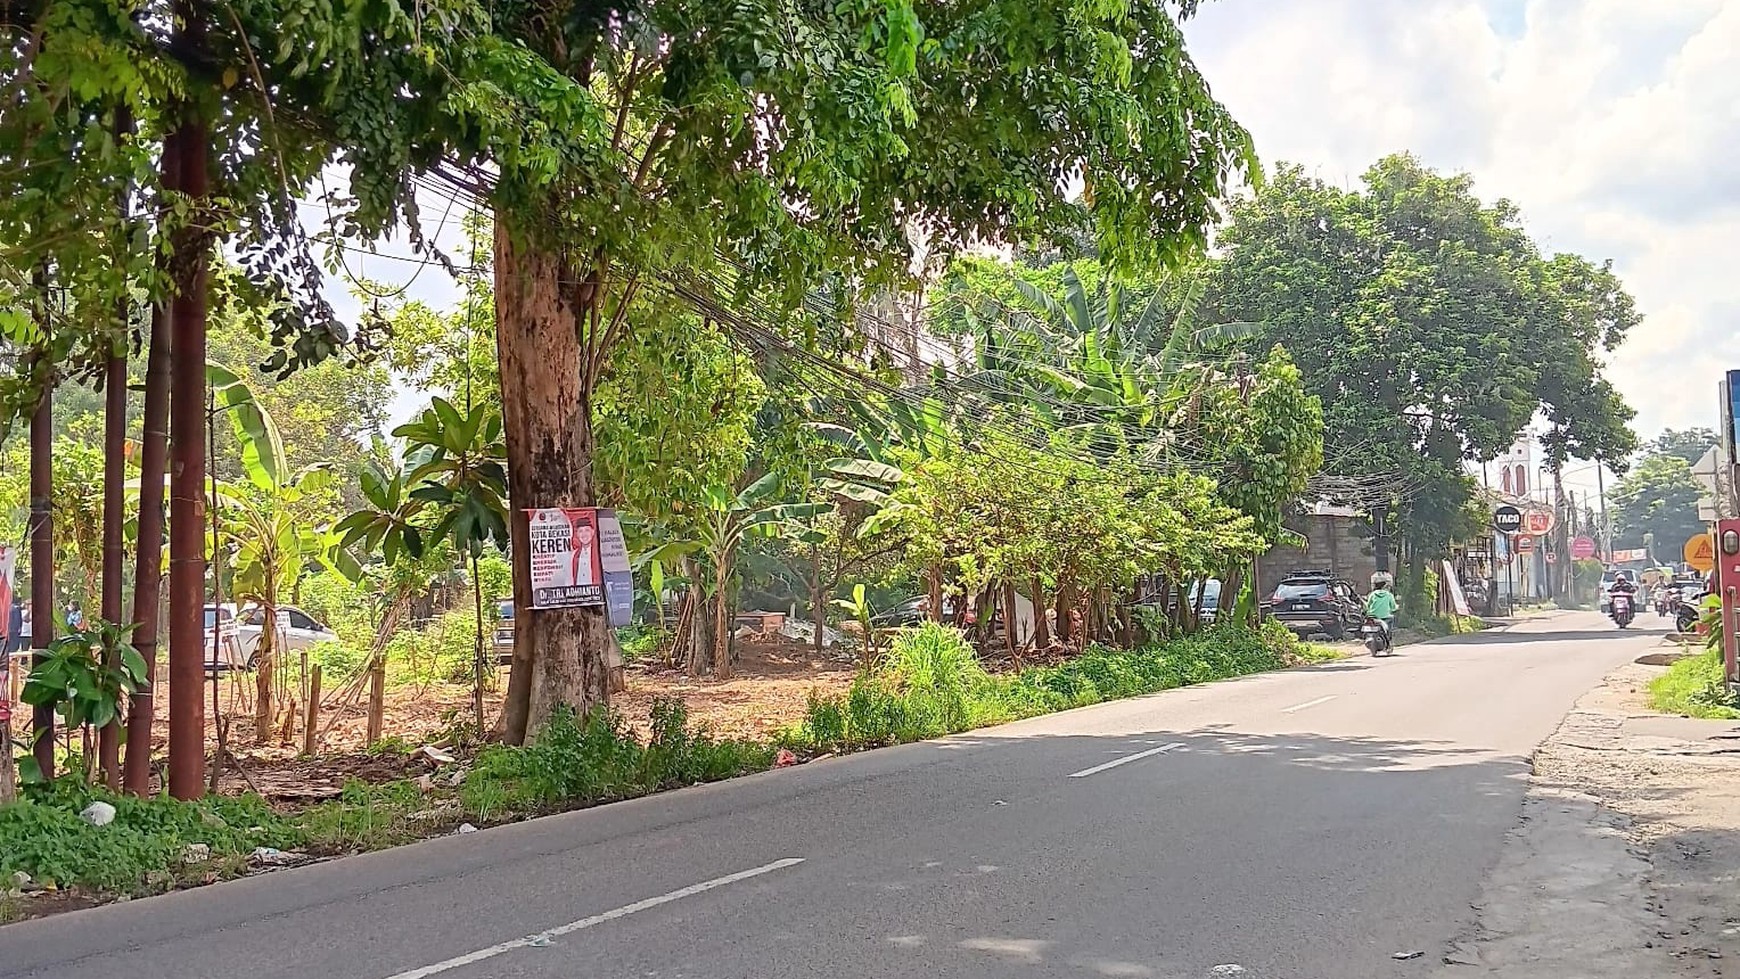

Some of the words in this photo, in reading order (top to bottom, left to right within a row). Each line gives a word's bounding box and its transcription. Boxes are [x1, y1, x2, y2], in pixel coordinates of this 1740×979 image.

[1496, 514, 1519, 523] TACO
[531, 531, 547, 539] KOTA
[548, 529, 571, 538] BEKASI
[532, 538, 571, 553] KEREN
